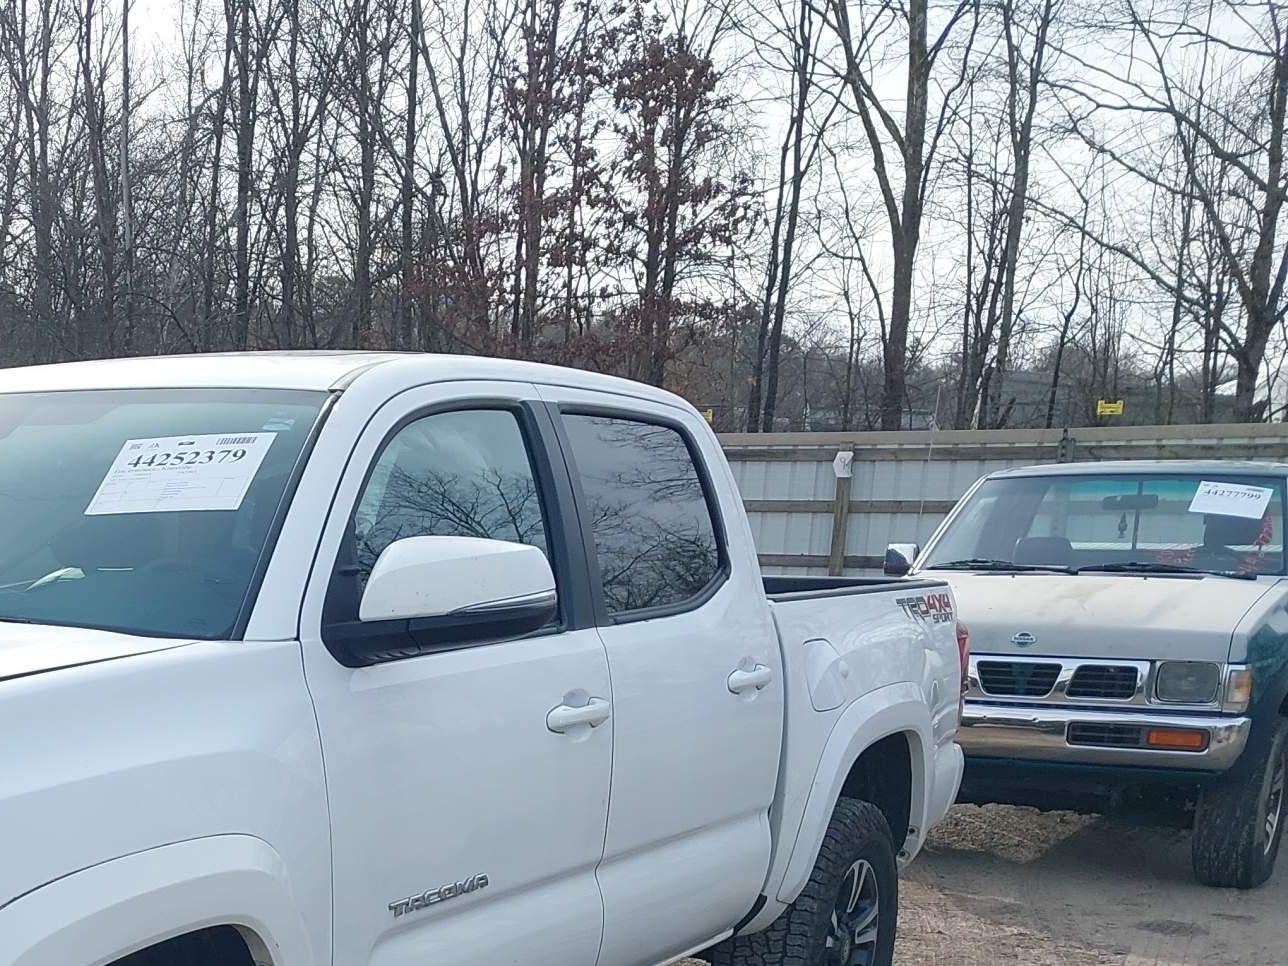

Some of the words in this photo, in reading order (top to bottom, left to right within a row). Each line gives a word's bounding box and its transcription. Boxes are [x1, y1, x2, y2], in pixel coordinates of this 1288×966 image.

[128, 448, 247, 467] 44252379
[1203, 488, 1262, 500] 44277799
[896, 596, 930, 626] TRD
[932, 612, 953, 624] SPORT
[388, 872, 489, 918] TACOMA
